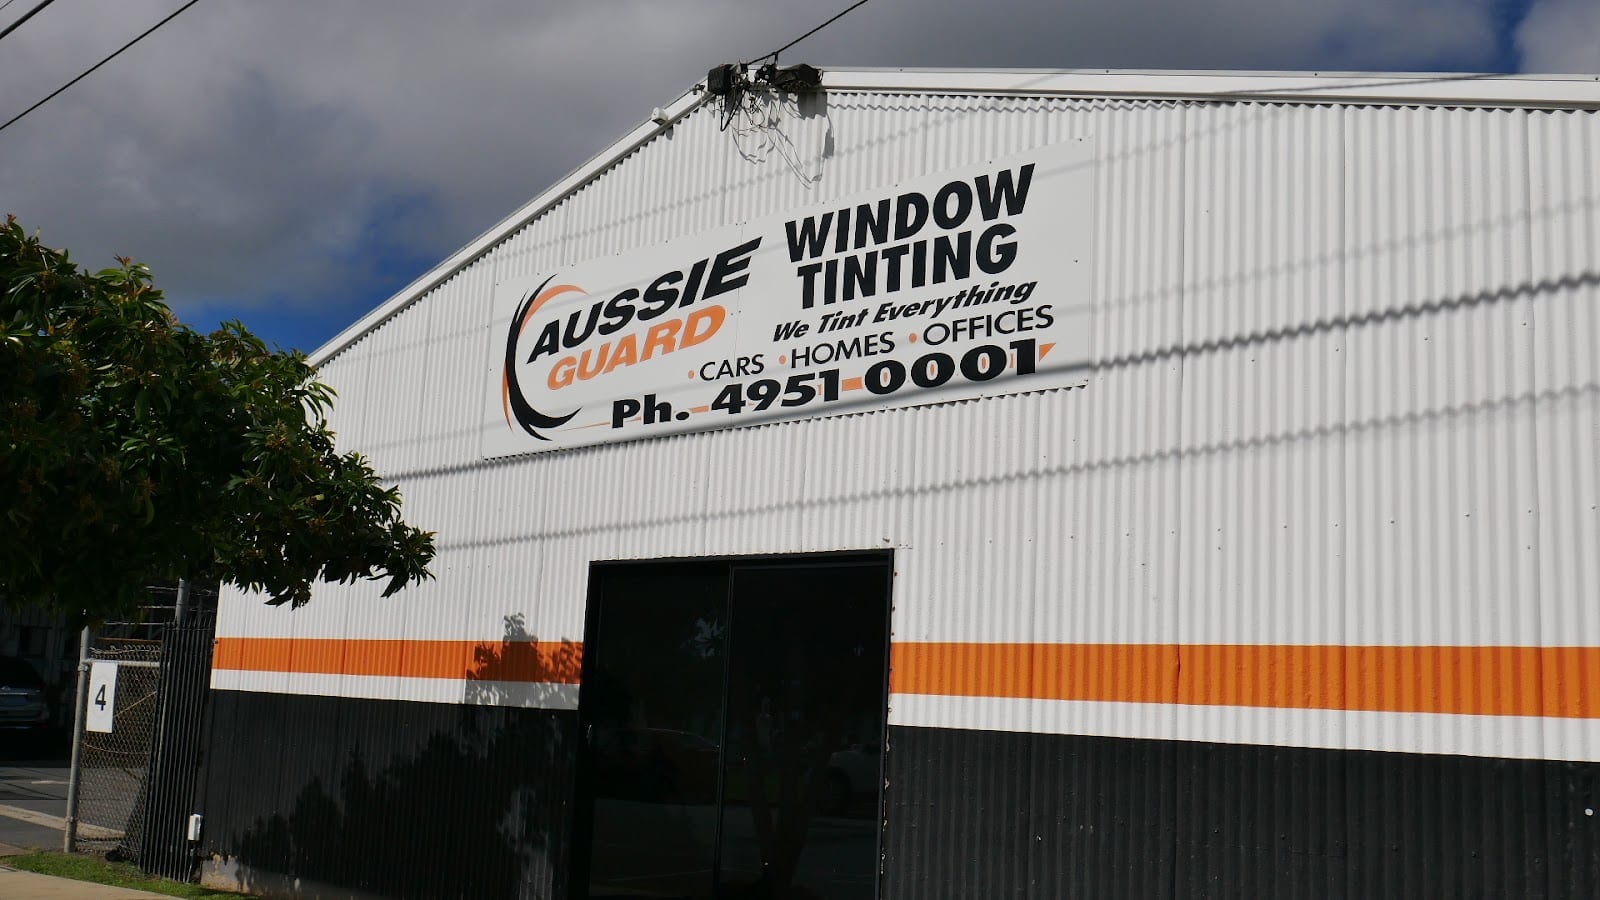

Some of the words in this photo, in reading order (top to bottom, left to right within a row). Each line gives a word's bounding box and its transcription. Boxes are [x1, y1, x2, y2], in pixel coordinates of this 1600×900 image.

[784, 163, 1036, 263] WINDOW
[526, 236, 763, 364] AUSSIE
[797, 224, 1018, 309] TINTING
[547, 305, 726, 390] GUARD
[699, 353, 765, 382] CARS
[790, 331, 895, 369] HOMES
[923, 304, 1055, 346] OFFICES
[773, 320, 809, 342] We
[820, 310, 869, 333] Tint
[873, 281, 1037, 324] Everything
[611, 394, 690, 429] Ph.
[95, 684, 107, 712] 4
